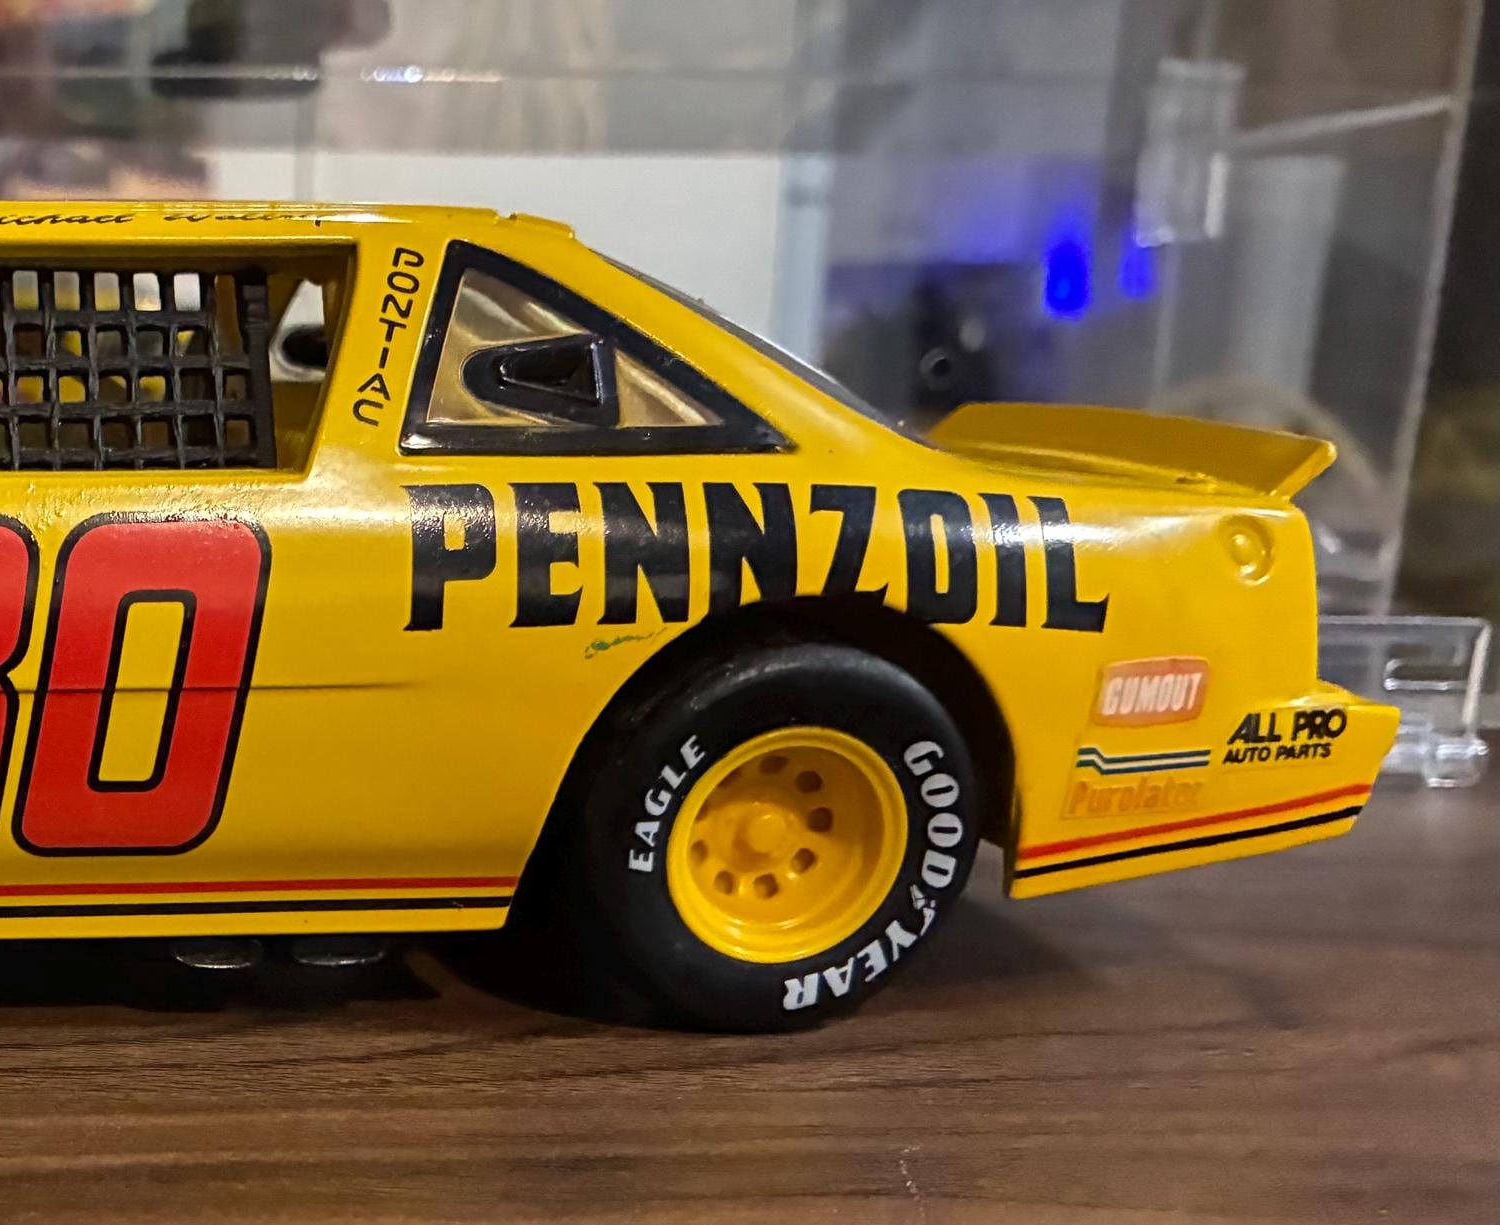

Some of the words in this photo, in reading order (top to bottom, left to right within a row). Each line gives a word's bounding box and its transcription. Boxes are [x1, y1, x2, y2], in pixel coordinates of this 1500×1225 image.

[352, 247, 425, 427] PONTIAC
[401, 481, 1110, 634] PENNZOIL
[1101, 672, 1203, 716] GUMOUT
[1222, 746, 1270, 765] AUTO
[1274, 743, 1332, 761] PARTS
[1226, 712, 1282, 745] ALL
[1290, 708, 1348, 741] PRO
[628, 734, 707, 873] EAGLE
[782, 740, 964, 1012] GOODYEAR
